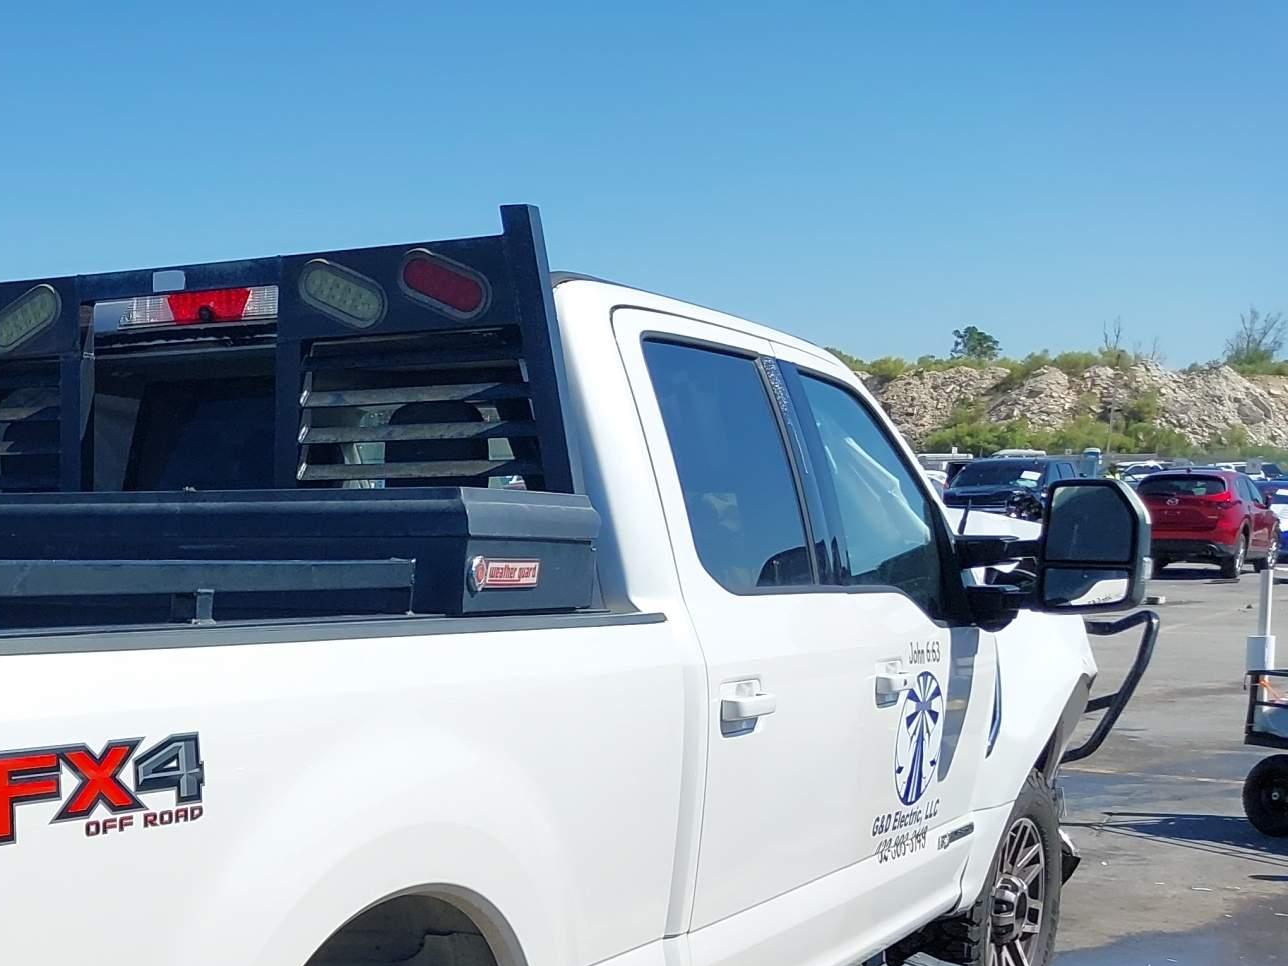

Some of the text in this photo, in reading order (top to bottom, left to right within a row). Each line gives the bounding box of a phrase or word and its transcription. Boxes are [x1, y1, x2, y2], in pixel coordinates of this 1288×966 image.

[488, 564, 537, 578] weather guard
[909, 641, 925, 664] John
[85, 805, 204, 837] OFF ROAD
[872, 799, 940, 837] G&D Electric, LLC
